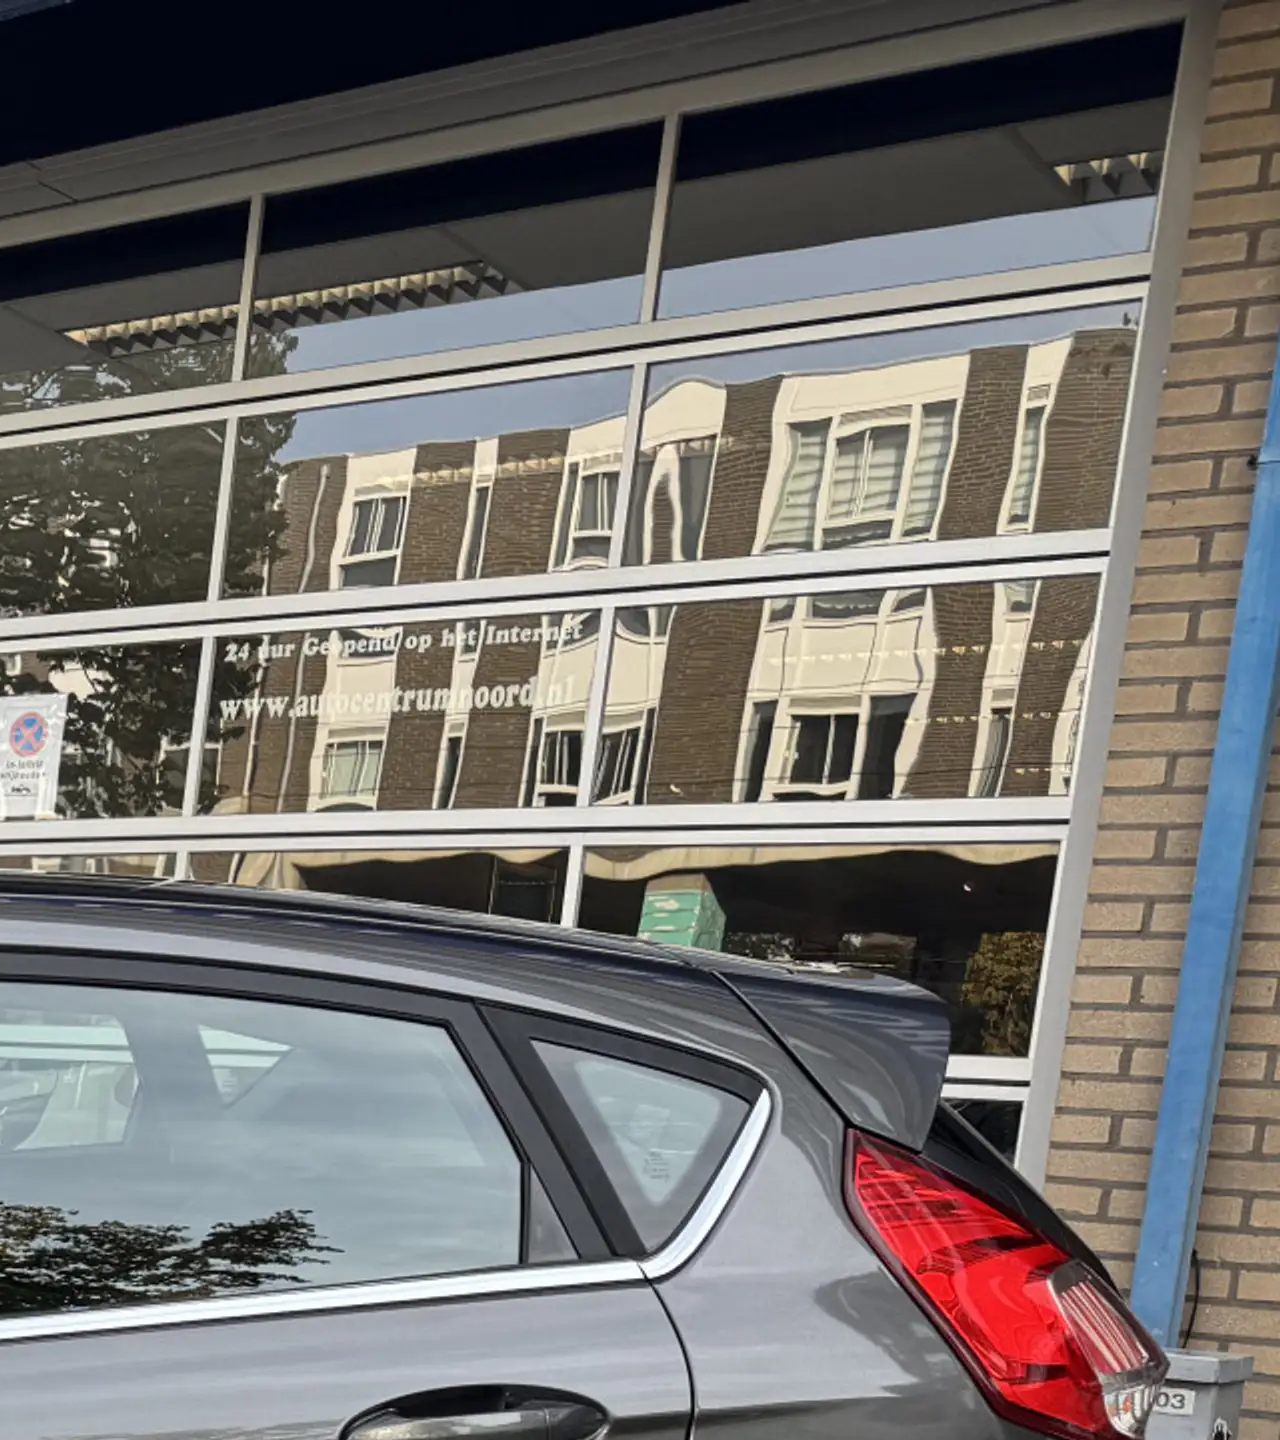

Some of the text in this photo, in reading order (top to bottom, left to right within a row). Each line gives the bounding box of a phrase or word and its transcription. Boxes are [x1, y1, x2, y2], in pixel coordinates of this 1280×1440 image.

[225, 623, 584, 663] 24 uur Geopend op het Internet
[220, 676, 575, 723] www.autocentrumnoord.nl
